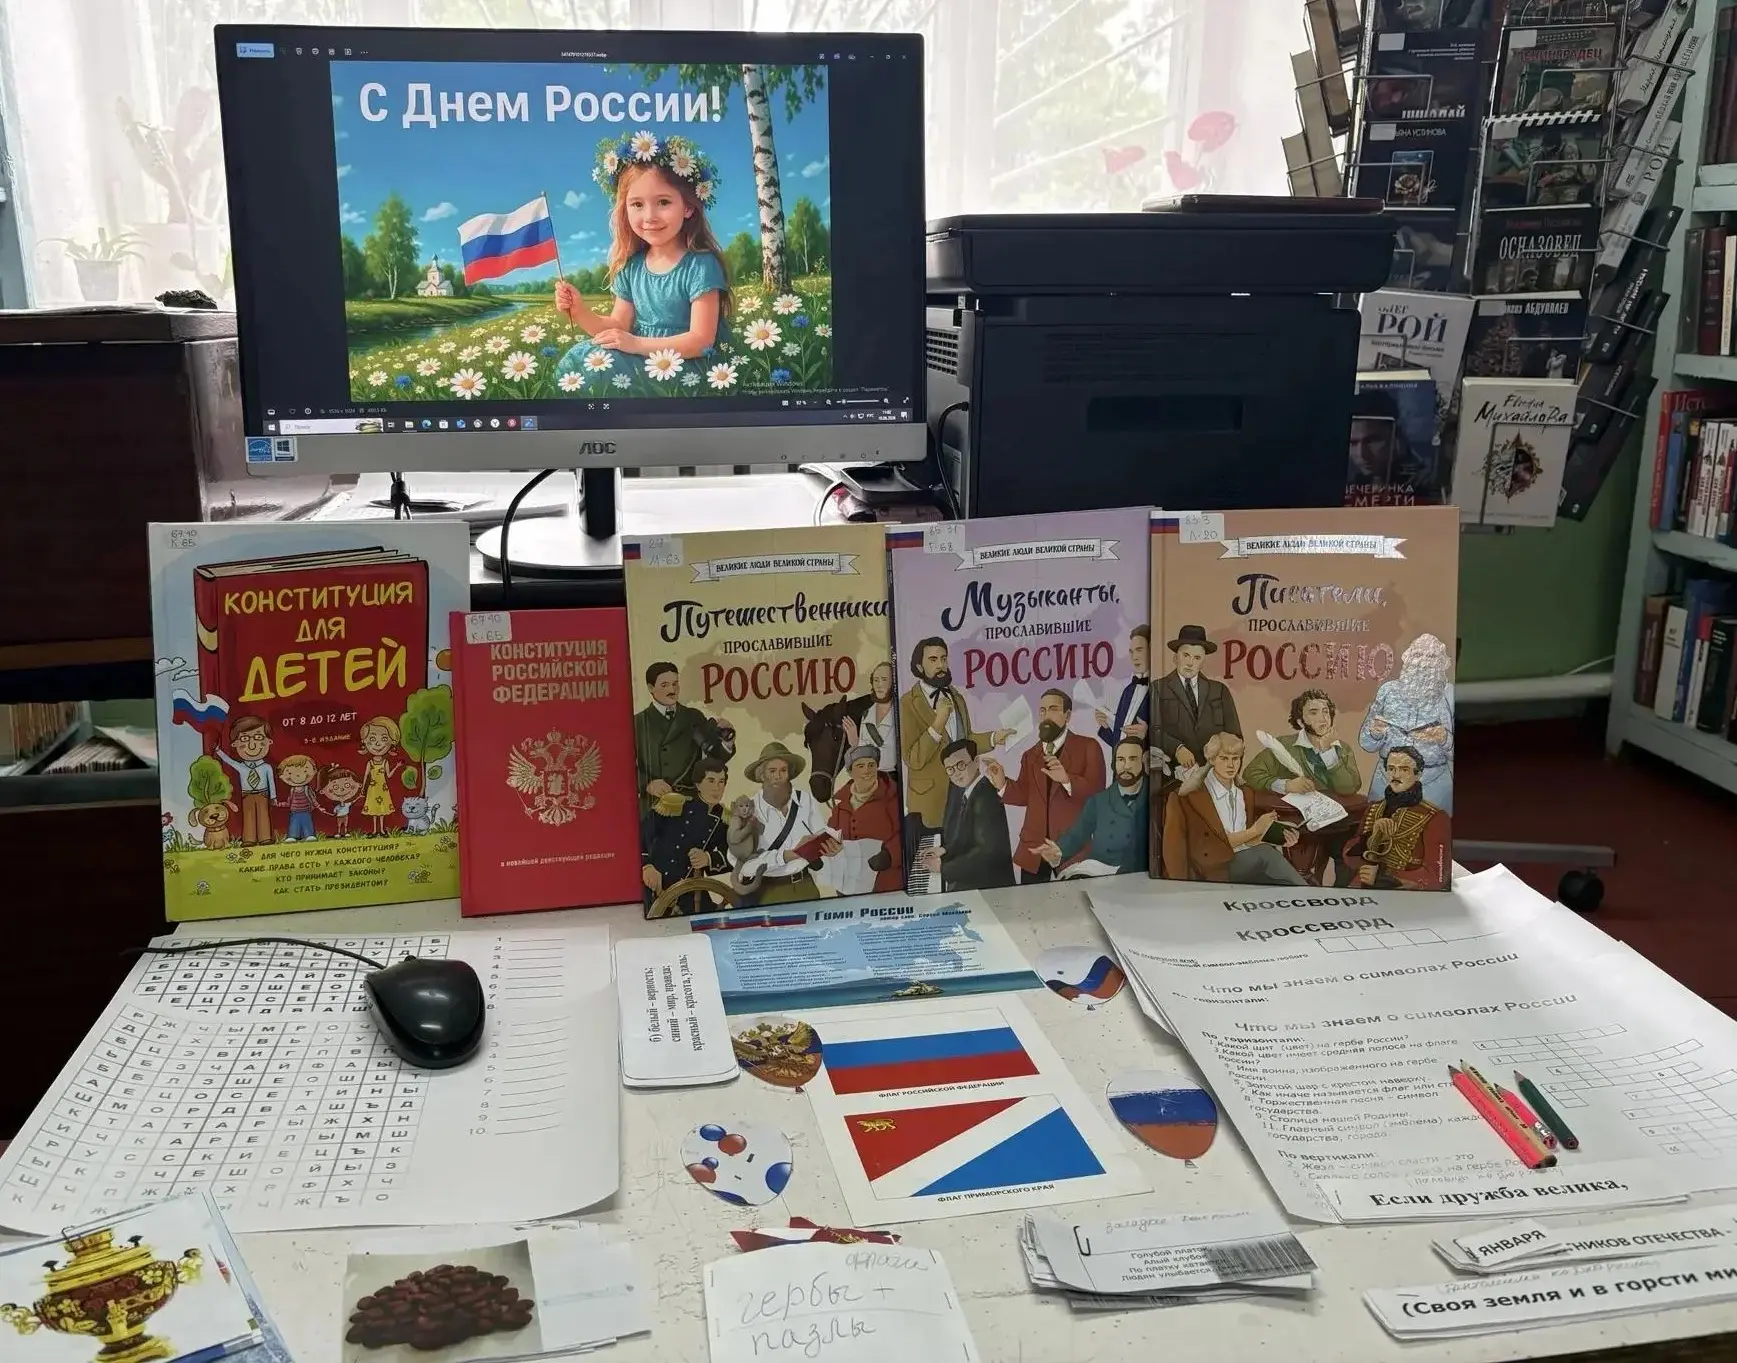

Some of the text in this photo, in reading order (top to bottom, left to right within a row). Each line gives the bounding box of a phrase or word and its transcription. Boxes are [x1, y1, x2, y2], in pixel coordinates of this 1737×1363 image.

[359, 82, 721, 129] С Днем России!
[1500, 234, 1582, 261] ОСНАЗОВЕЦ
[1377, 312, 1447, 342] РОЙ
[579, 440, 616, 455] AOC
[980, 543, 1095, 560] ВЕЛИКИЕ ЛЮДИ ВЕЛИКОЙ СТРАНЫ
[1246, 540, 1281, 550] ВЕЛИКИЕ
[1308, 539, 1344, 549] ВЕЛИКОЙ
[1345, 540, 1377, 550] СТРАНЫ
[716, 557, 835, 572] ВЕЛИКИЕ ЛЮДИ ВЕЛИКОЙ СТРАНЫ
[223, 581, 414, 616] КОНСТИТУЦИЯ
[660, 592, 890, 643] Путешественники
[1248, 618, 1370, 632] ПРОСЛАВИВШИЕ
[295, 616, 347, 643] ДЛЯ
[985, 619, 1092, 640] ПРОСЛАВИВШИЕ
[490, 640, 608, 660] КОНСТИТУЦИЯ
[724, 634, 833, 654] ПРОСЛАВИВШИЕ
[238, 637, 407, 703] ДЕТЕЙ
[492, 657, 608, 681] РОССИЙСКОЙ
[963, 640, 1115, 690] РОССИЮ
[1223, 639, 1395, 682] РОССИЮ
[701, 656, 856, 704] РОССИЮ
[492, 681, 609, 705] ФЕДЕРАЦИИ
[282, 711, 358, 727] ОТ 8 ДО 12 ЛЕТ
[260, 843, 400, 861] ДЛЯ ЧЕГО НУЖНА КОНСТИТУЦИЯ?
[238, 853, 421, 873] КАКИЕ ПРАВА ЕСТЬ КАЖДОГО ЧЕЛОВЕКА?
[275, 867, 386, 883] КТО ПРИНИМАЕТ ЗАКОНЫ?
[273, 878, 388, 896] КАК СТАТЬ ПРЕЗИДЕНТОМ?
[815, 906, 914, 921] Гимн России
[1223, 896, 1378, 913] Кроссворд
[1235, 914, 1392, 942] Кроссворд
[1203, 951, 1519, 994] Что мы знаем о символах России
[645, 967, 663, 1043] б) белый верность;
[1234, 993, 1577, 1032] Что мы знаем о символах России
[667, 1018, 681, 1043] синий
[686, 1016, 705, 1052] красный
[1202, 1031, 1218, 1039] По
[1321, 1047, 1365, 1057] средняя
[1368, 1044, 1406, 1052] полоса
[1425, 1039, 1458, 1048] флаге
[1334, 1039, 1363, 1047] гербе
[1367, 1035, 1409, 1043] России?
[1218, 1055, 1260, 1065] России?
[1236, 1065, 1258, 1073] Имя
[1407, 1057, 1438, 1065] гербе
[878, 1081, 1005, 1098] ФЛАГ РОССИЙСКОЙ ФЕДЕРАЦИИ
[1313, 1087, 1379, 1097] называется
[1382, 1086, 1409, 1094] флаг
[1397, 1091, 1439, 1099] символ
[1269, 1115, 1318, 1124] Столица
[1323, 1114, 1360, 1123] нашей
[1268, 1132, 1343, 1142] государства,
[1278, 1150, 1379, 1161] По вертикали:
[937, 1183, 1055, 1203] ФЛАГ ПРИМОРСКОГО КРАЯ
[1370, 1193, 1434, 1206] Если
[1439, 1183, 1529, 1207] дружба
[1533, 1177, 1629, 1198] велика,
[1479, 1229, 1548, 1257] ЯНВАРЯ
[1566, 1226, 1723, 1251] НИКОВ ОТЕЧЕСТВА
[1131, 1249, 1172, 1259] Голубой
[1144, 1253, 1208, 1265] Алый клубок
[1122, 1273, 1156, 1281] Людям
[1145, 1264, 1180, 1272] платку
[741, 1271, 865, 1324] гербы
[1402, 1300, 1476, 1318] (Своя
[1483, 1290, 1562, 1309] земля
[1567, 1286, 1585, 1298] и
[1592, 1285, 1608, 1295] в
[1615, 1271, 1699, 1293] горсти
[1707, 1267, 1737, 1280] ми
[752, 1317, 877, 1358] пазлы
